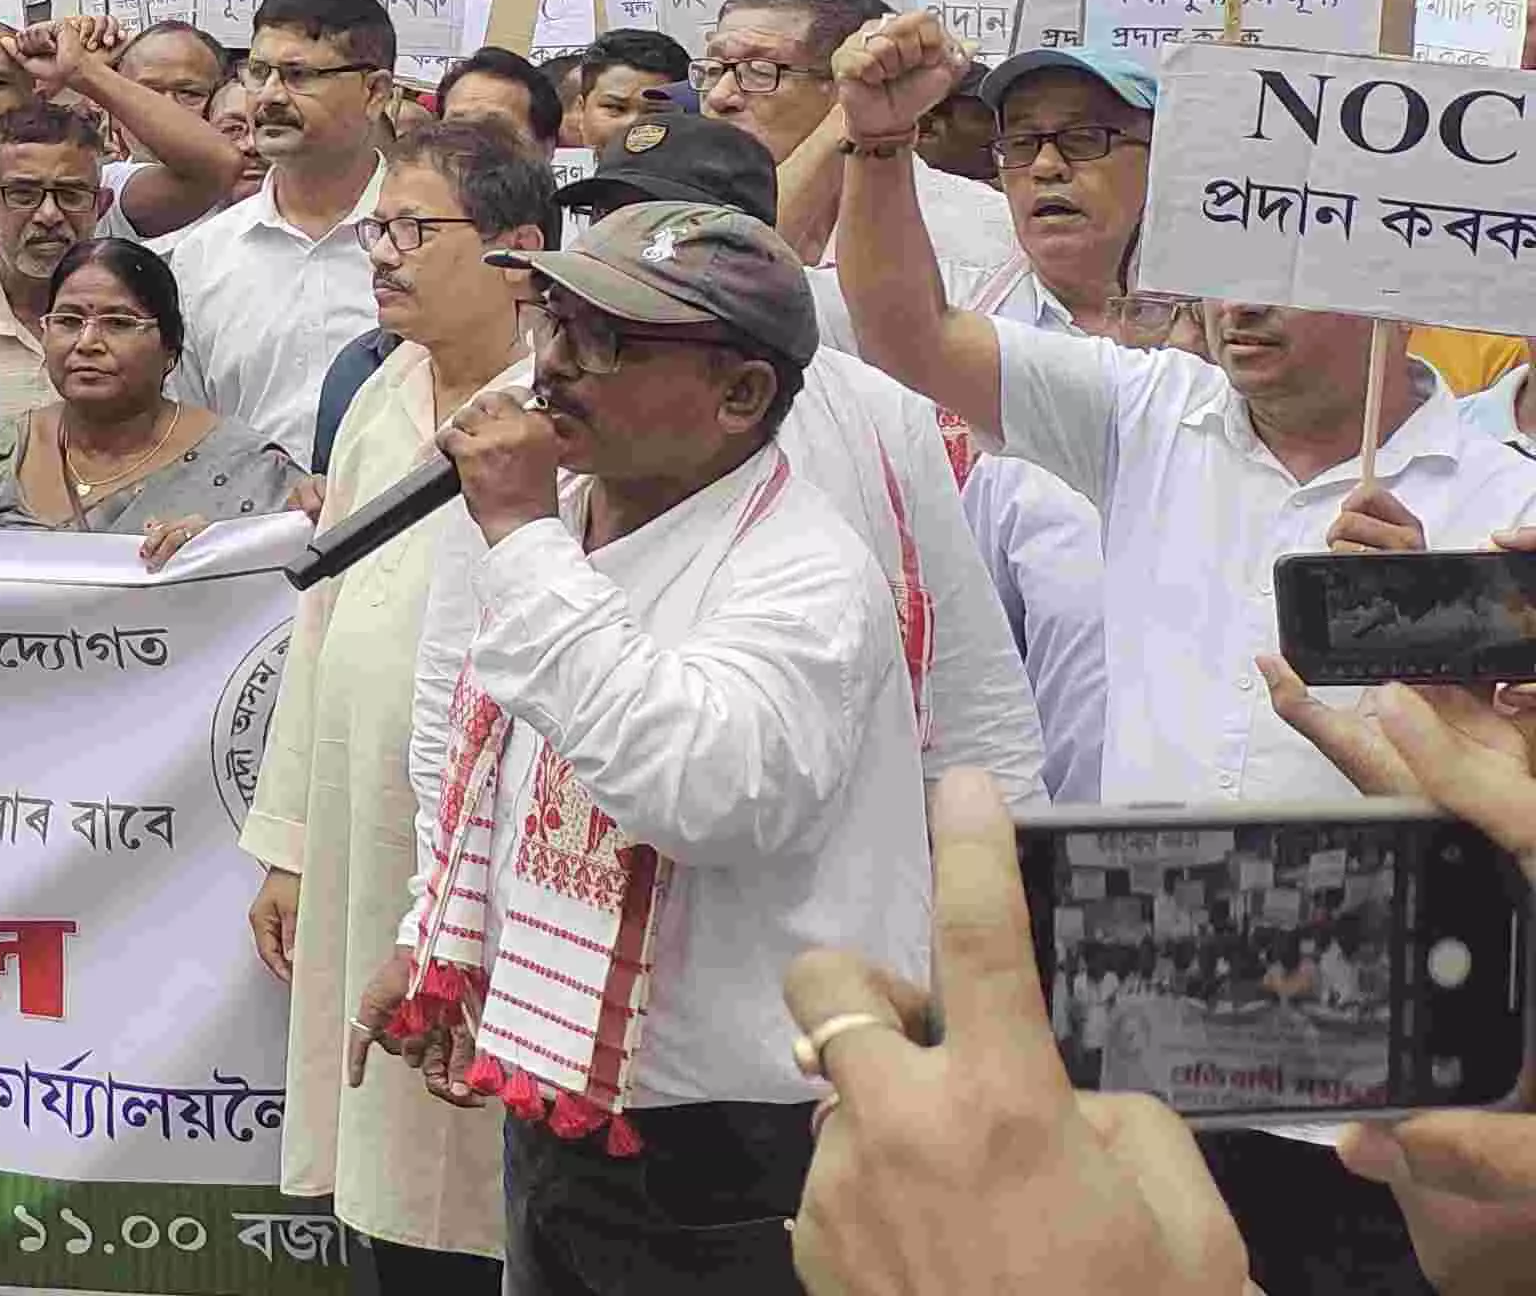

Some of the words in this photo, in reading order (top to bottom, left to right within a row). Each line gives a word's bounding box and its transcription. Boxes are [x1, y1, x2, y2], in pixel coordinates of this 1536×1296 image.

[1245, 69, 1526, 165] NOC
[1202, 176, 1359, 241] প্ৰদান
[1379, 198, 1536, 259] কৰক
[73, 800, 175, 852] বাবে
[14, 1203, 208, 1256] ১১.০০
